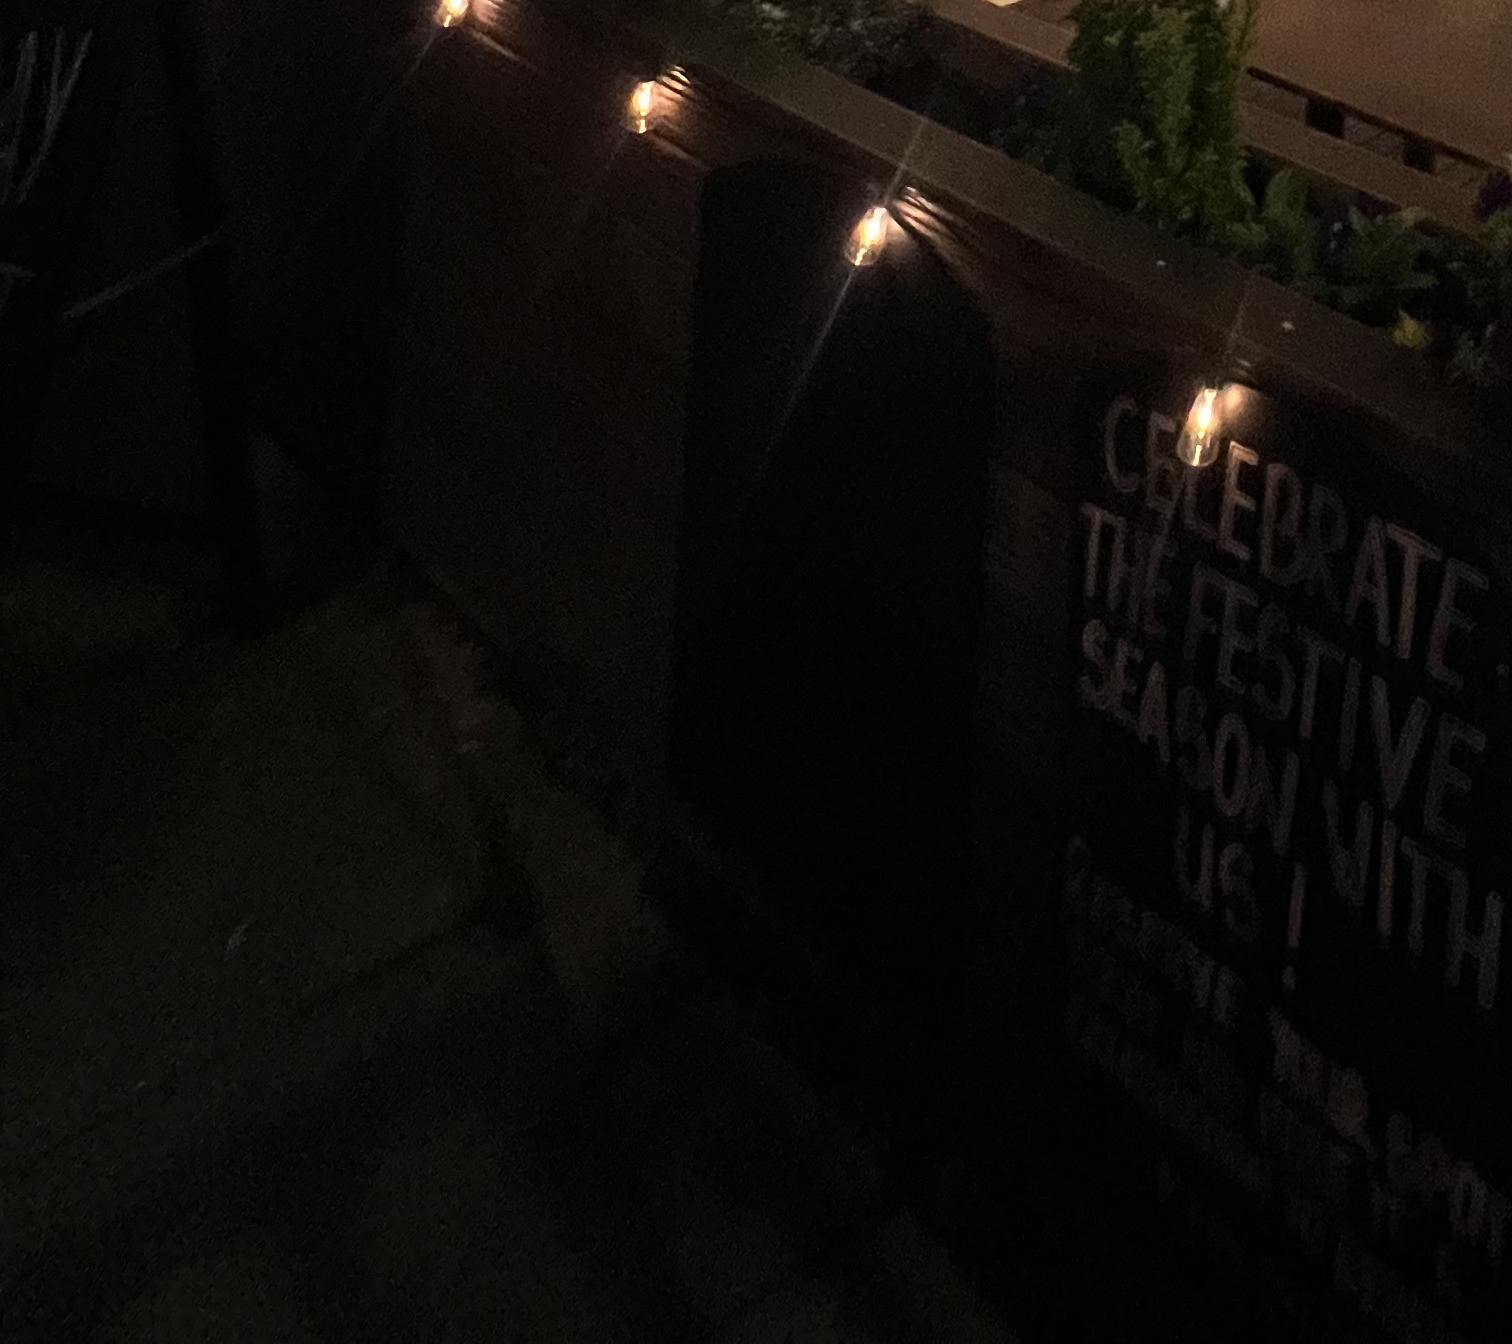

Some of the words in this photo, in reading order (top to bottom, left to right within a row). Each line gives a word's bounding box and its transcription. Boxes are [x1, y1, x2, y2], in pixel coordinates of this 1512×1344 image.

[1080, 501, 1176, 640] THE
[1183, 558, 1489, 852] FESTIVE
[1101, 393, 1491, 692] CELEBRATE
[1078, 617, 1300, 858] SEASON
[1320, 776, 1506, 1012] WITH
